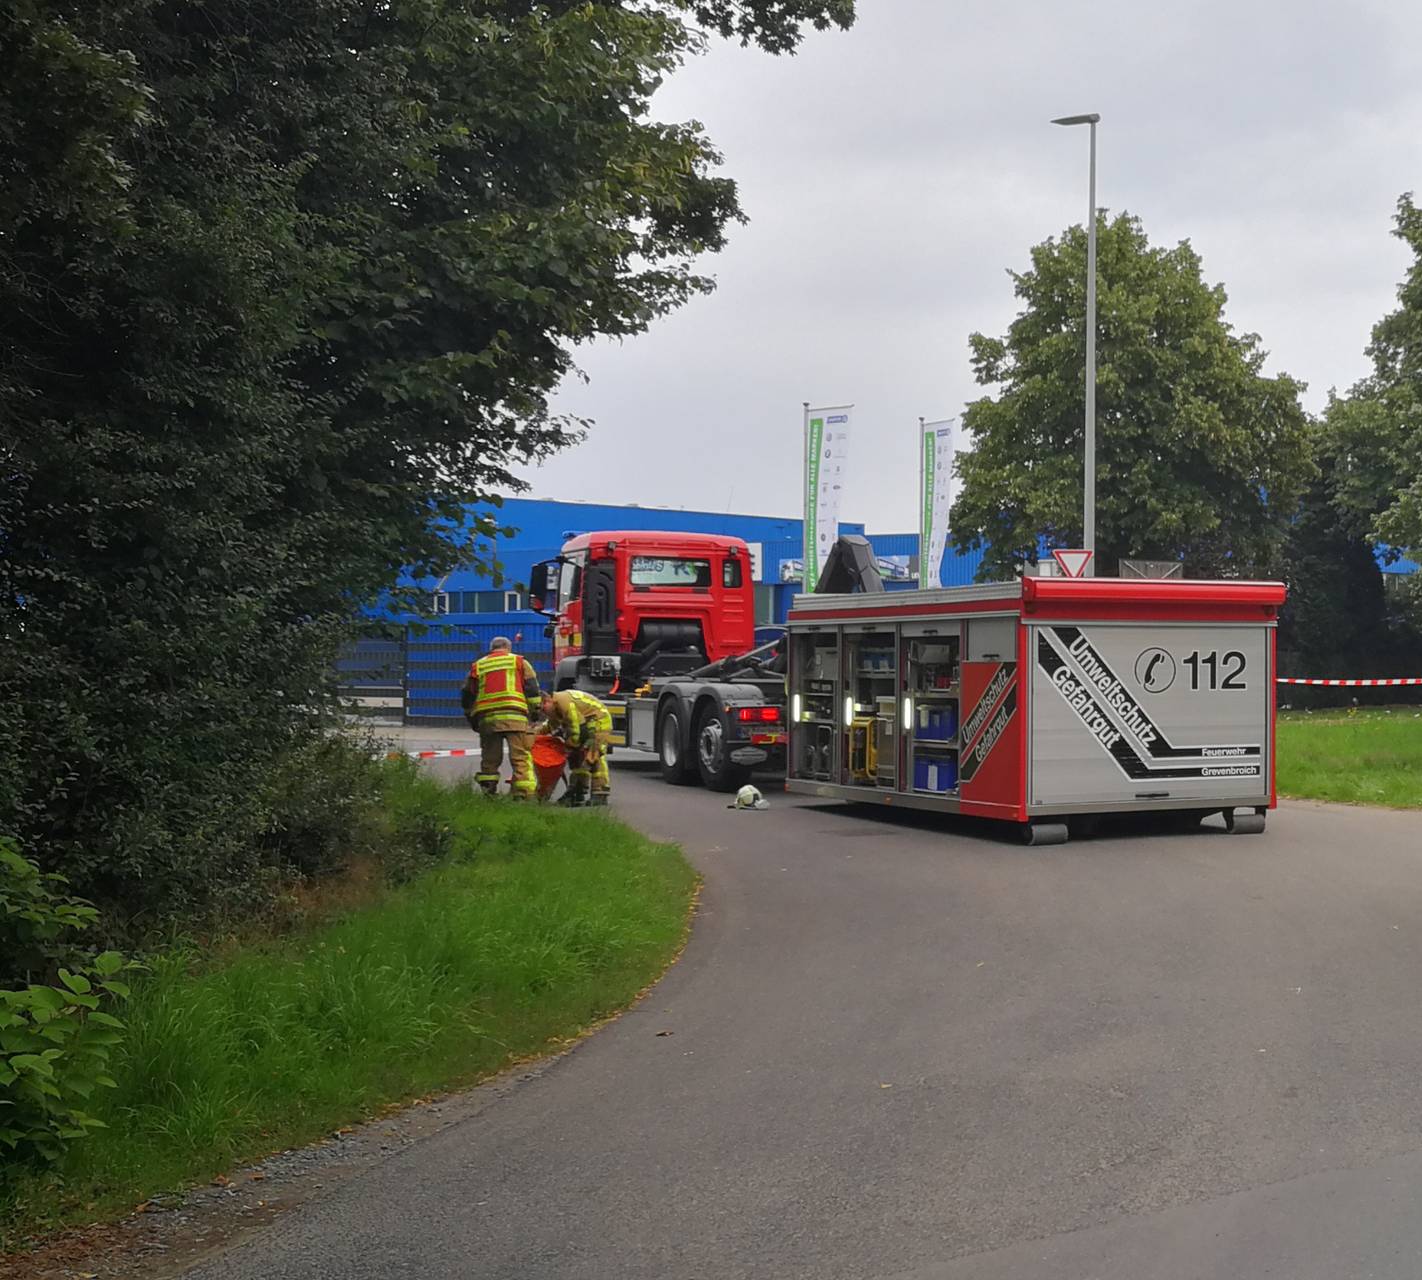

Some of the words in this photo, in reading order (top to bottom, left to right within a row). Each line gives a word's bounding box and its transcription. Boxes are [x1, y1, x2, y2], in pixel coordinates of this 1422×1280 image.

[1069, 635, 1158, 748] Umweltschutz
[1182, 650, 1247, 691] 112
[962, 668, 1009, 744] Umweltschutz
[975, 705, 1009, 762] Gefahrgut
[1052, 665, 1122, 749] Gefahrgut
[1201, 746, 1247, 757] Feuerwehr
[1201, 765, 1257, 777] Grevenbroich
